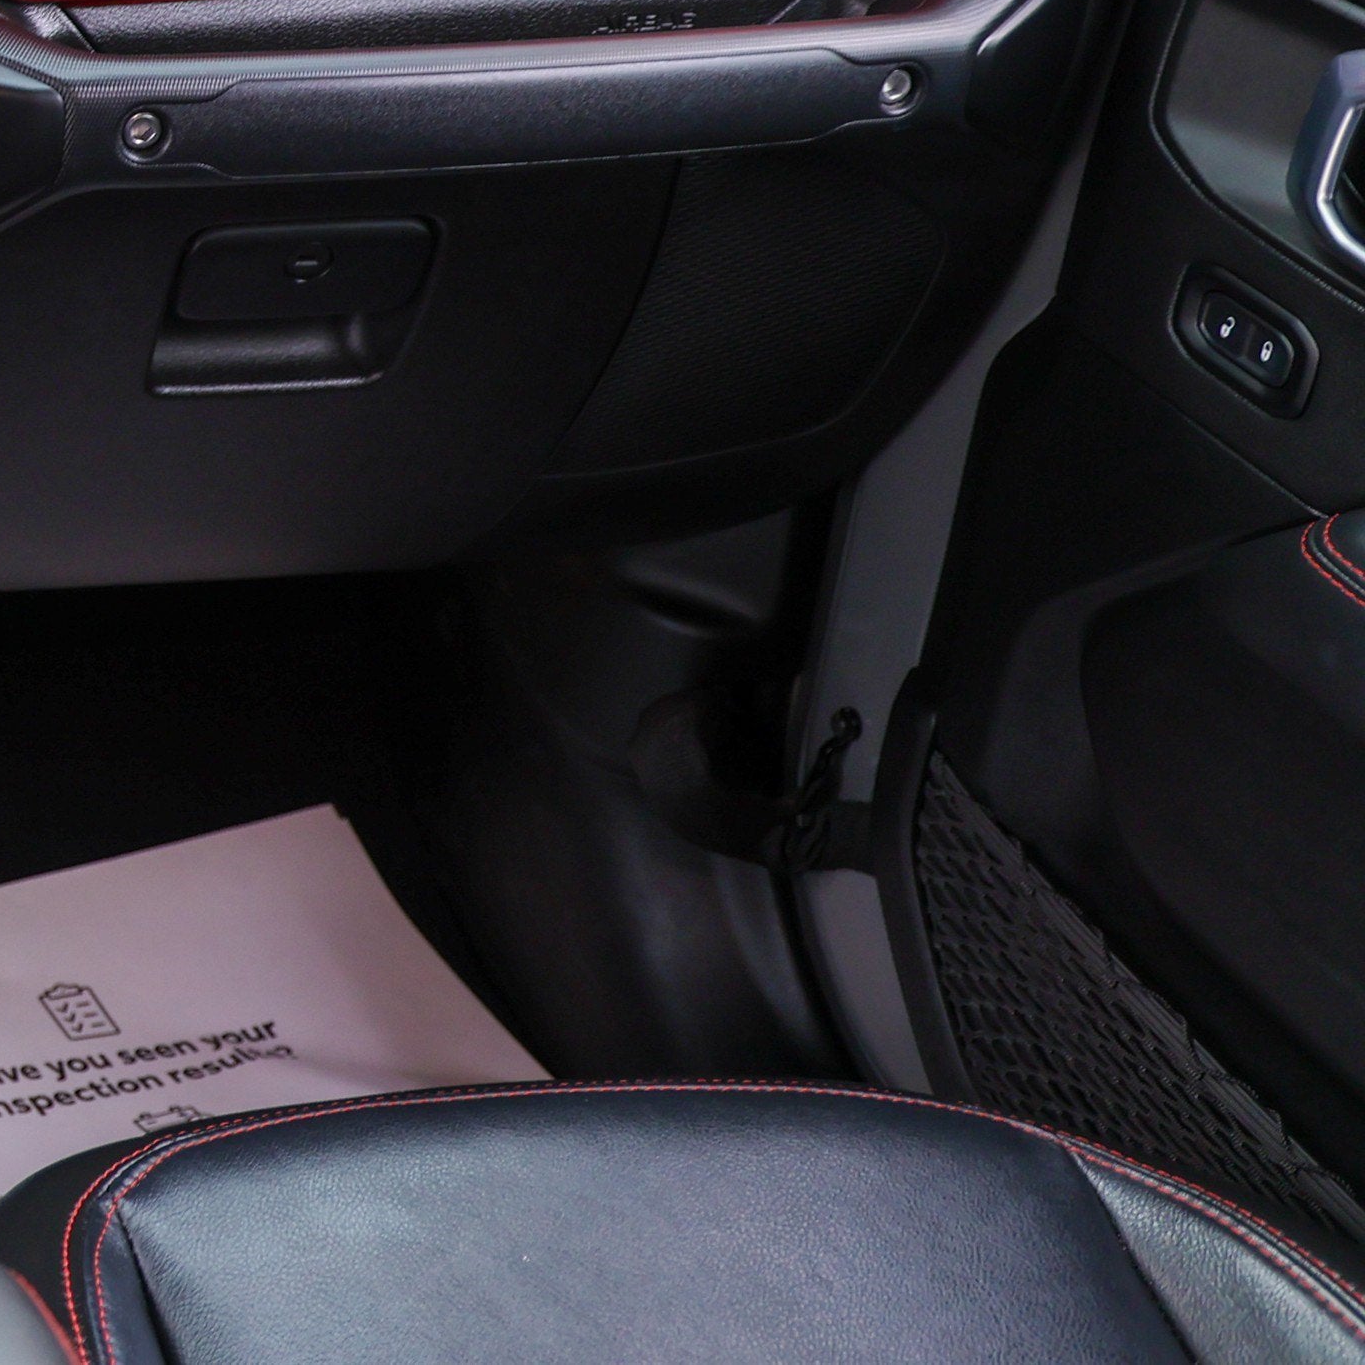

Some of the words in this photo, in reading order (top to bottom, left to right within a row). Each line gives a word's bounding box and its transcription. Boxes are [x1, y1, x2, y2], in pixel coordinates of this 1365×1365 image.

[44, 1049, 112, 1082] you
[116, 1038, 200, 1066] seen
[199, 1020, 277, 1052] your
